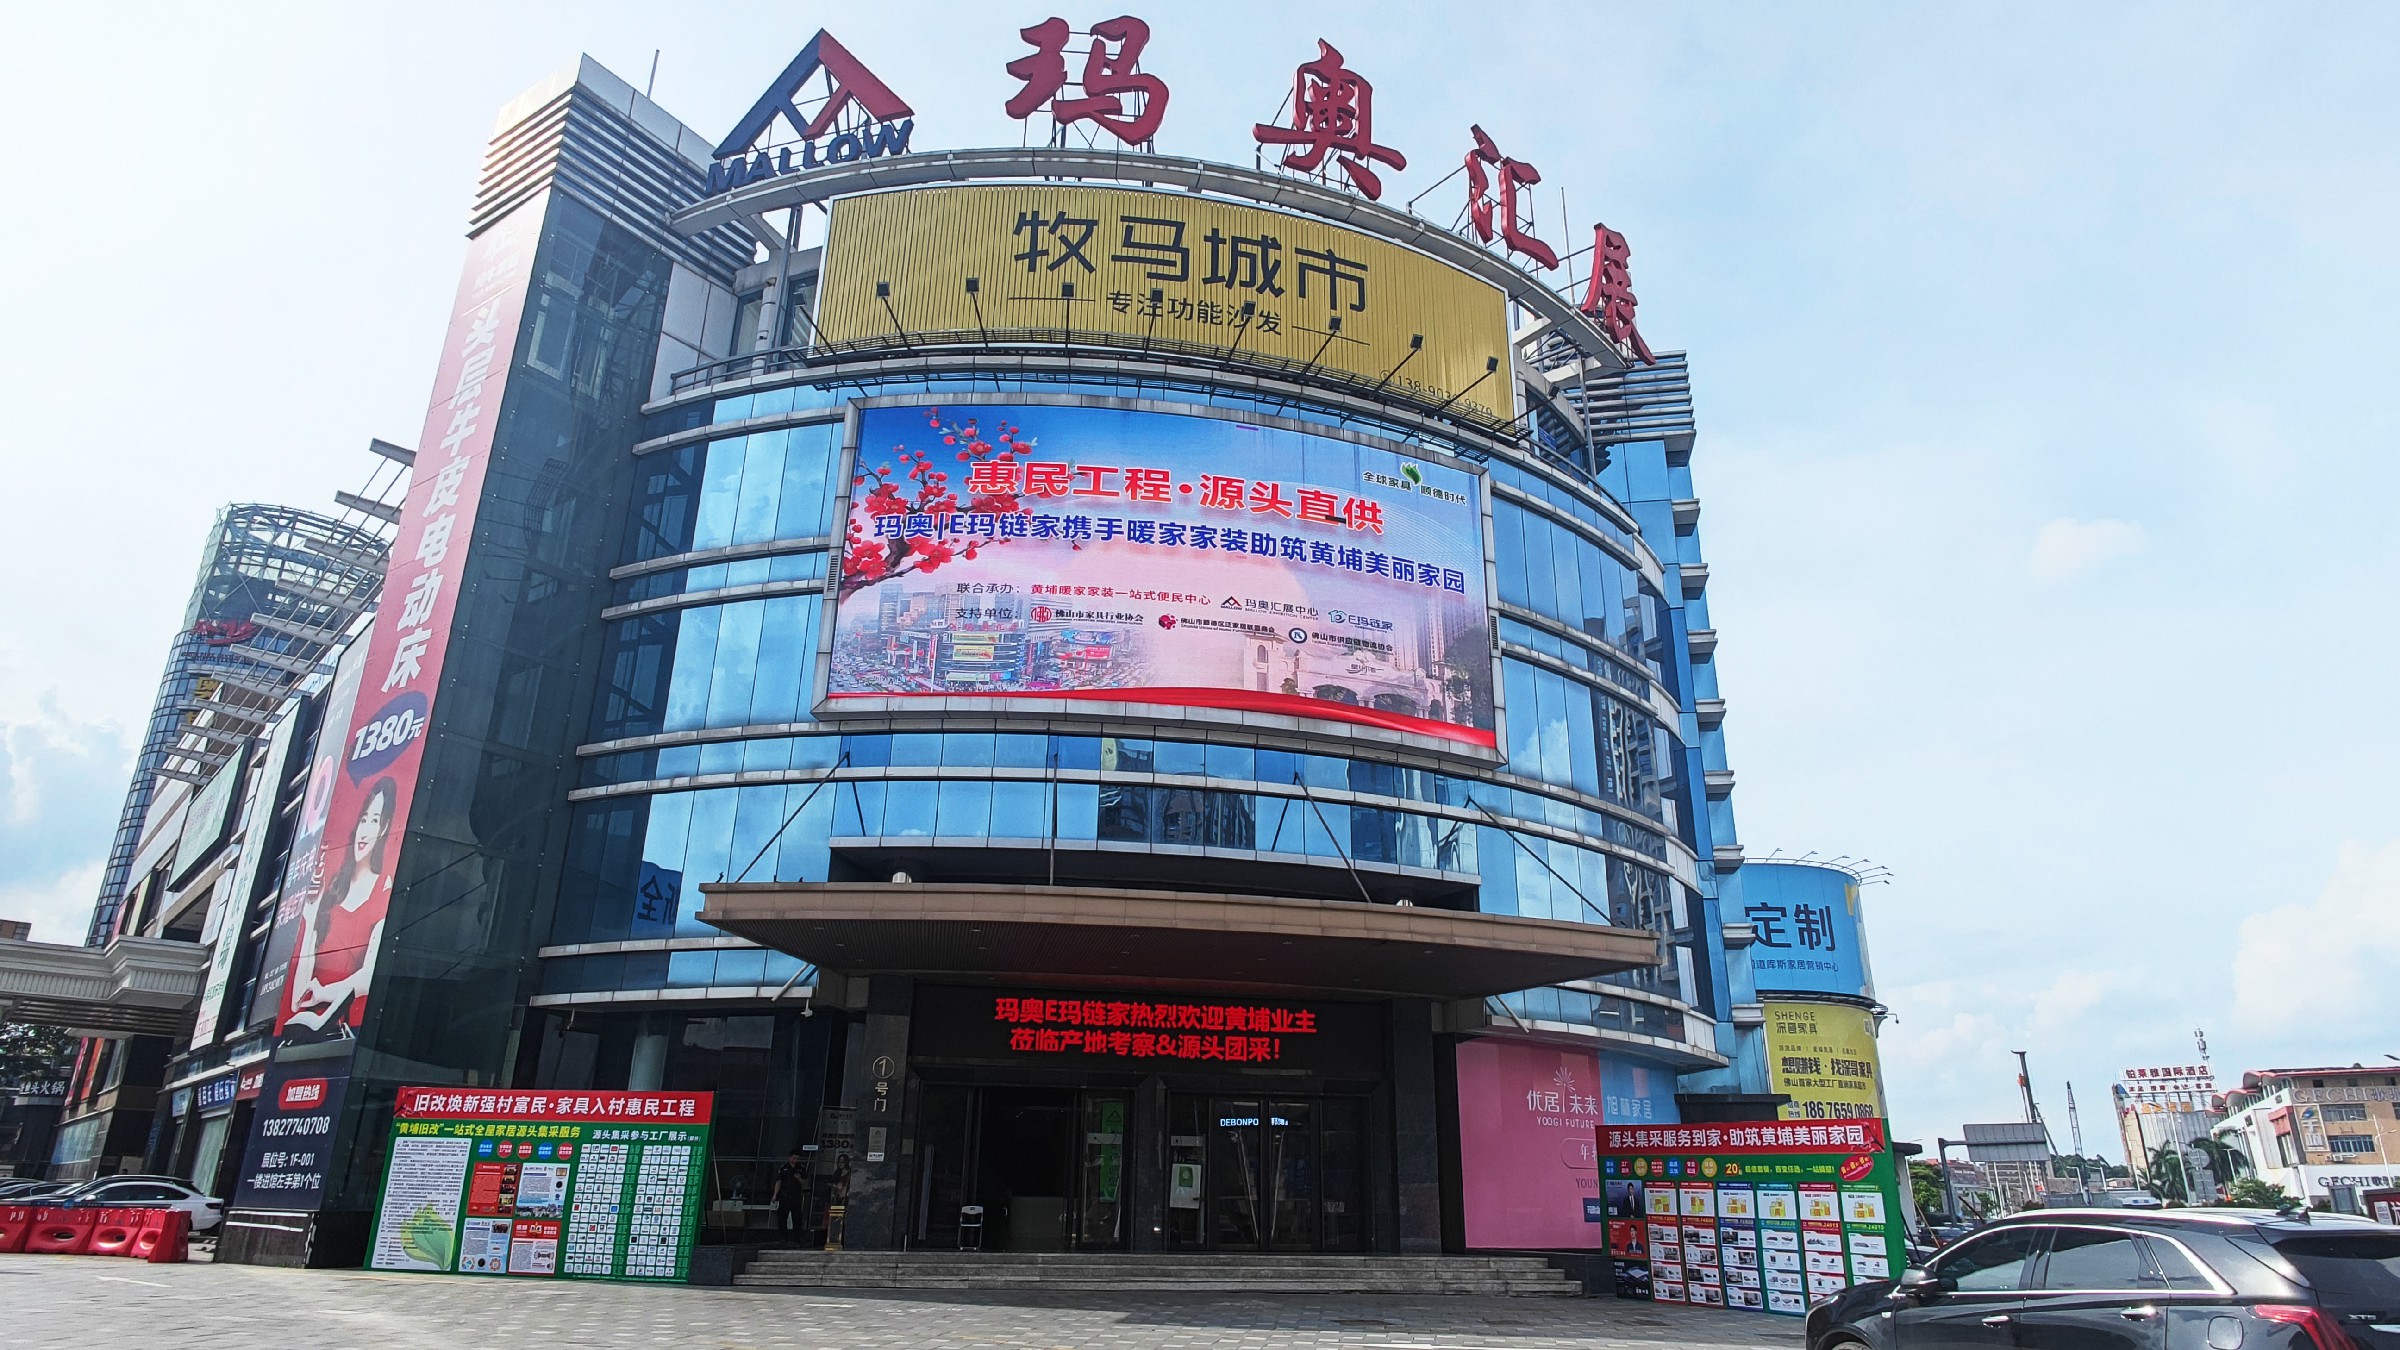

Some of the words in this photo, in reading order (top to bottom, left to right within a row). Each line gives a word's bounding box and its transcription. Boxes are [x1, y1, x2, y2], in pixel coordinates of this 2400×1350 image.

[706, 119, 914, 197] MALLOW
[1005, 15, 1656, 365] 玛奥汇展
[1013, 210, 1369, 313] 牧马城市
[1107, 290, 1282, 336] 专注功能沙发
[968, 460, 1385, 536] 惠民工程·源头直供
[1362, 471, 1412, 491] 全球家具
[1245, 598, 1319, 617] 玛奥汇展中心
[351, 707, 426, 763] 1380元
[1744, 901, 1837, 952] 定制
[994, 997, 1318, 1034] 玛奥E玛链家热烈欢迎黄埔业主
[1774, 1010, 1816, 1022] SHENGE
[262, 1115, 331, 1137] 13827740708
[1565, 1118, 1595, 1130] FUTURE
[1802, 1101, 1825, 1119] 186
[1826, 1101, 1854, 1119] 7659
